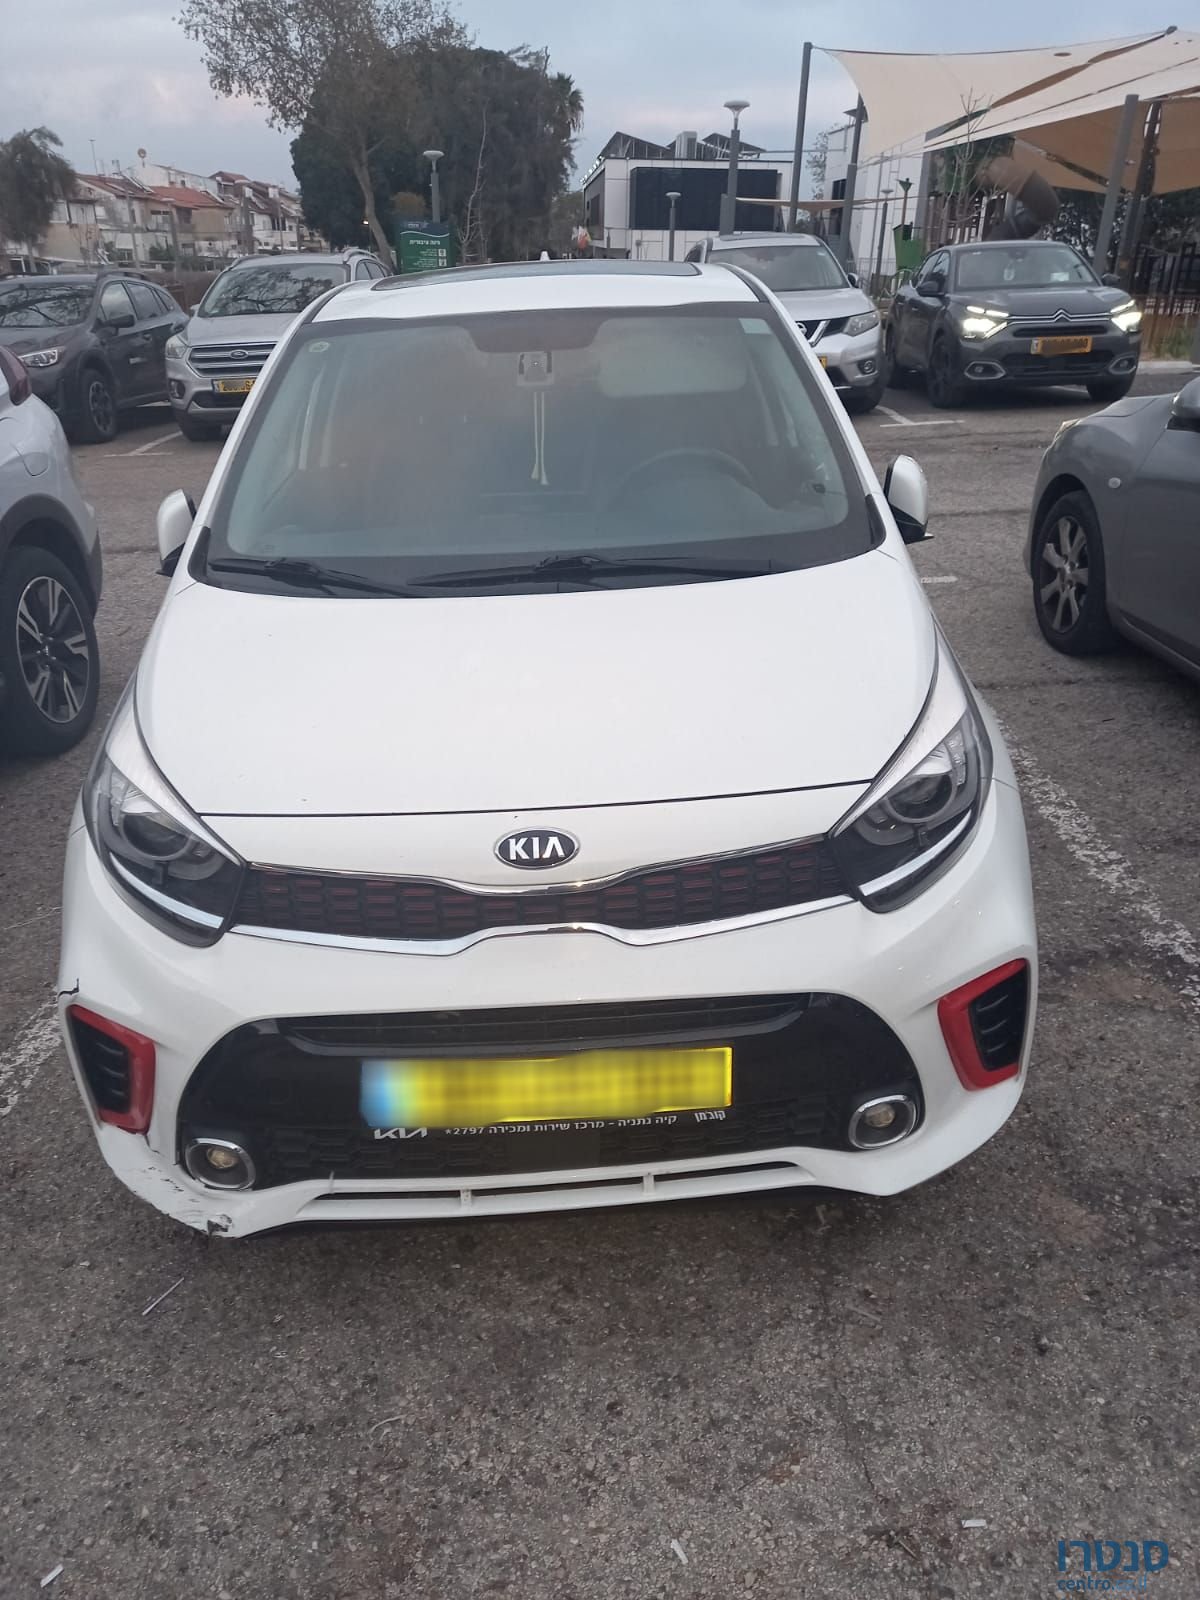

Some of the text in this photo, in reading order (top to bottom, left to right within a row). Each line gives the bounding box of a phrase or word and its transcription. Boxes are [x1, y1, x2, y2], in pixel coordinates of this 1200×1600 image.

[508, 836, 565, 860] KIA
[618, 1117, 652, 1127] נתניה
[655, 1115, 677, 1125] קיה
[488, 1125, 531, 1134] ומכירה
[533, 1123, 570, 1132] שירות
[574, 1121, 605, 1130] מרכז
